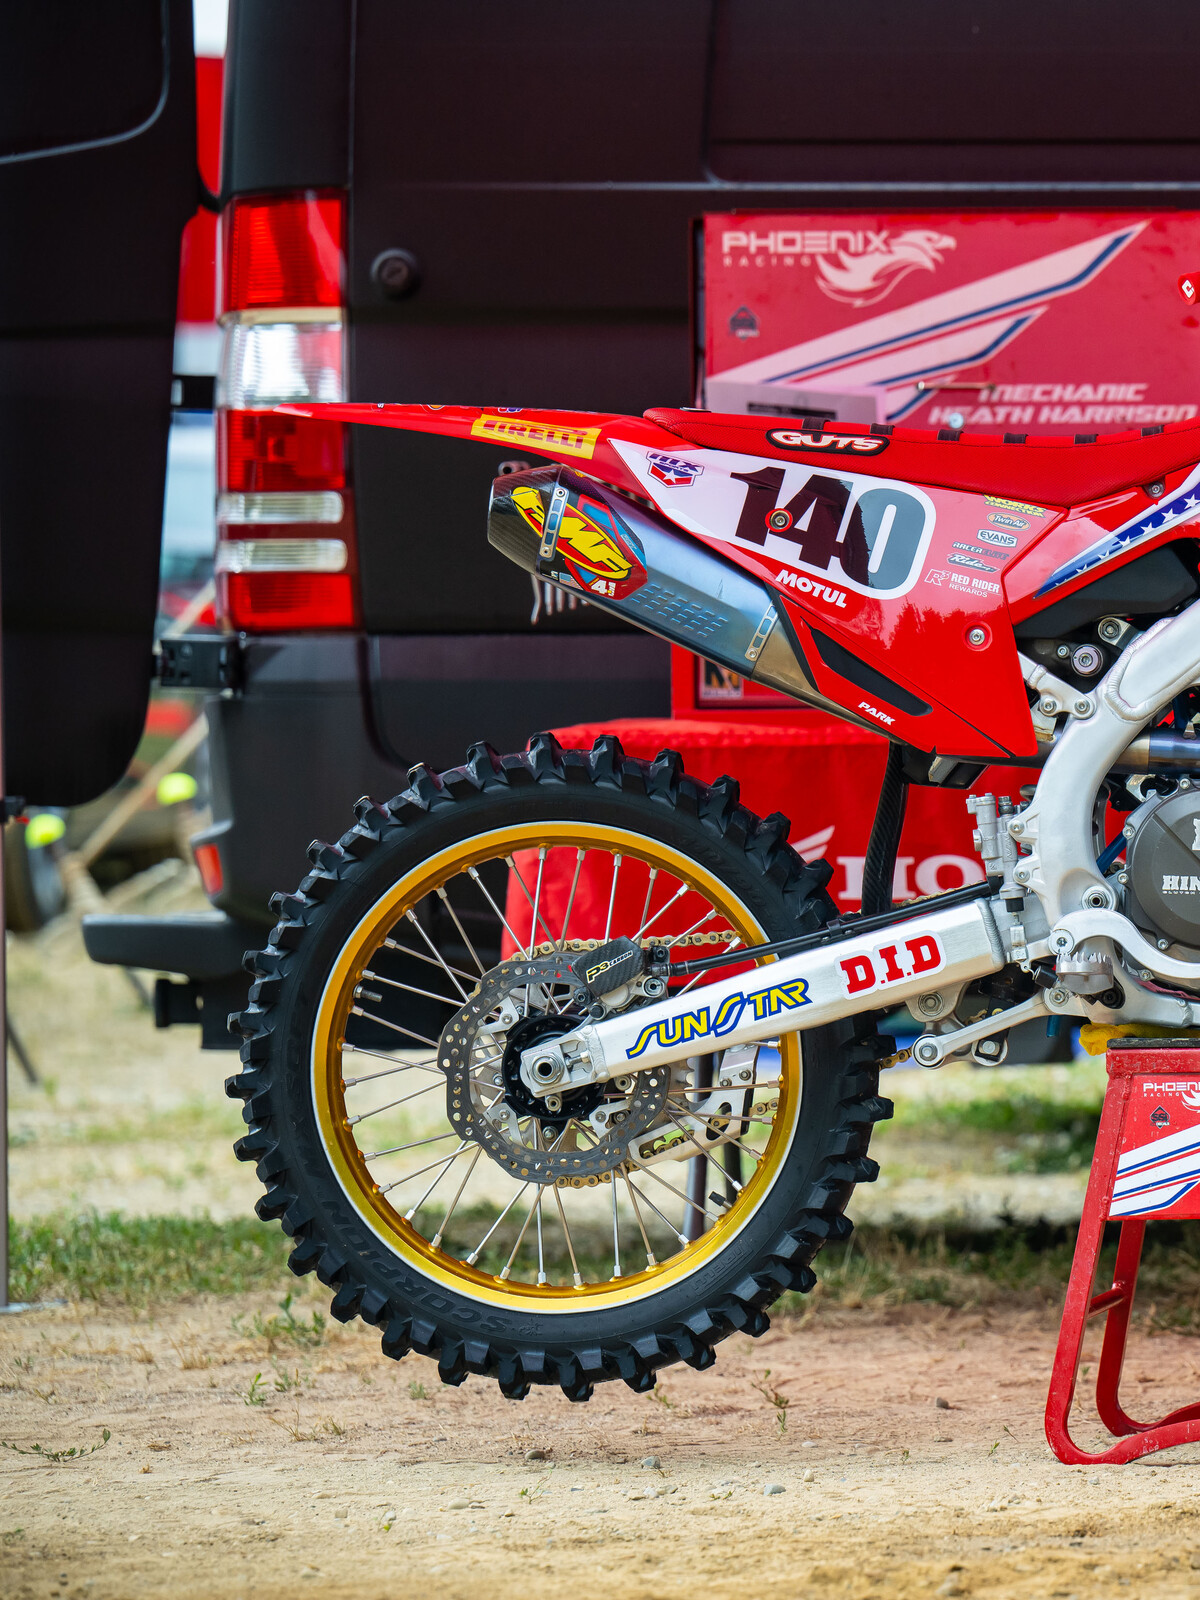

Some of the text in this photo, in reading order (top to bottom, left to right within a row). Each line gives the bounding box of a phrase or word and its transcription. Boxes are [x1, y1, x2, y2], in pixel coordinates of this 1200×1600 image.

[722, 230, 892, 253] PHOENIX
[722, 256, 812, 267] RACING
[978, 384, 1149, 402] MECHANIC
[1051, 404, 1198, 424] HARRISON
[483, 420, 588, 449] PIRELLI
[771, 430, 885, 452] GUTS
[649, 453, 700, 473] MX
[983, 494, 1047, 512] WORKS
[510, 487, 633, 573] FMF
[730, 466, 926, 592] 140
[994, 514, 1027, 528] Twin Air
[980, 530, 1015, 544] EVANS
[775, 569, 847, 609] MOTUL
[949, 583, 988, 598] REWARDS
[951, 573, 970, 585] RED
[971, 578, 1000, 594] RIDER
[858, 702, 895, 726] PARK
[586, 950, 633, 983] P3 CARBON
[840, 935, 942, 995] D.I.D
